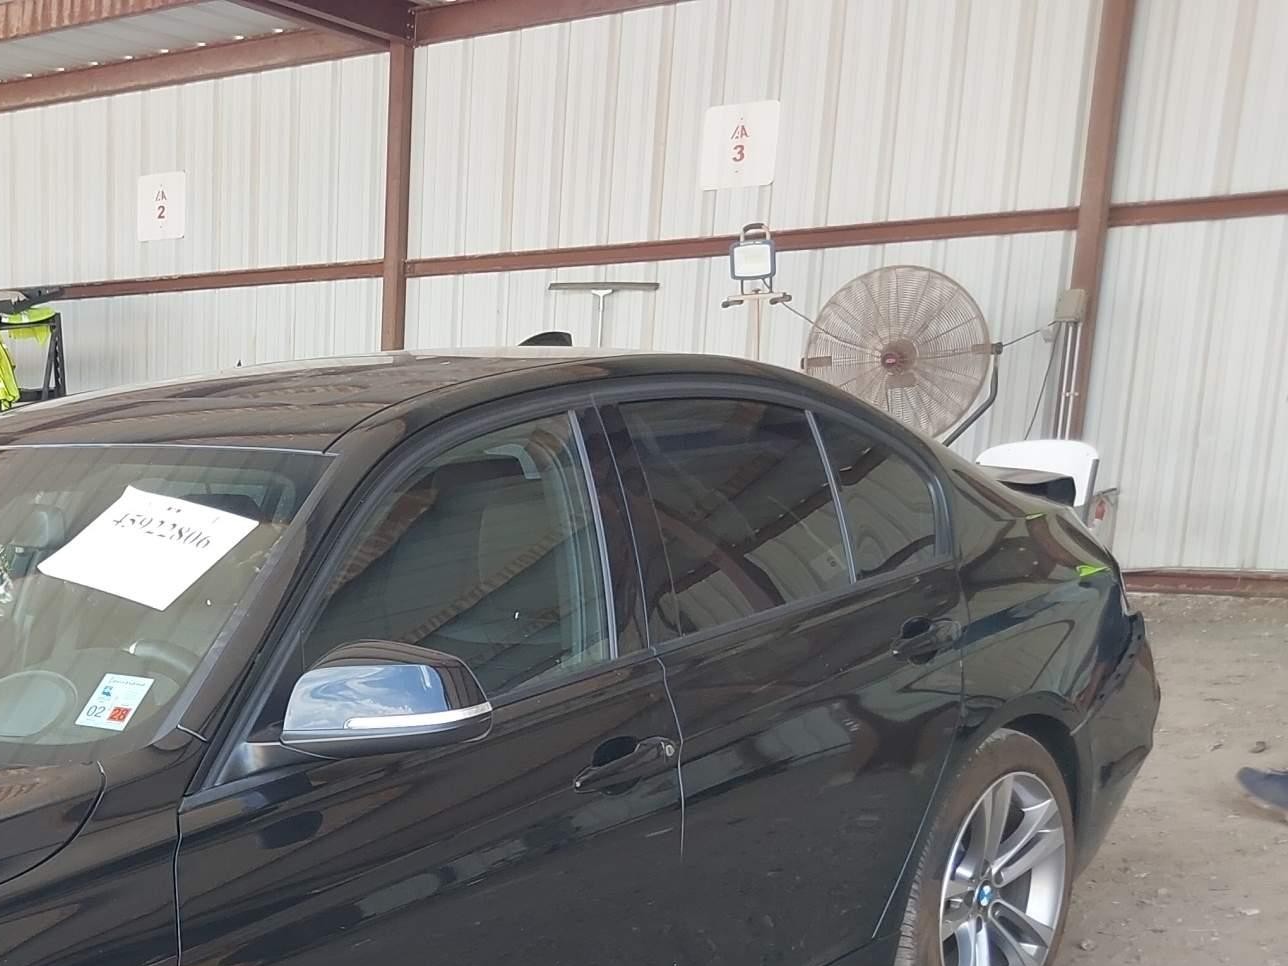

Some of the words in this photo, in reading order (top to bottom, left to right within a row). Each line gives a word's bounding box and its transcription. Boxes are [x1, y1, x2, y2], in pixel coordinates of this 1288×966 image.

[732, 144, 745, 162] 3
[157, 205, 166, 219] 2
[86, 704, 106, 718] 02
[109, 707, 129, 722] 28
